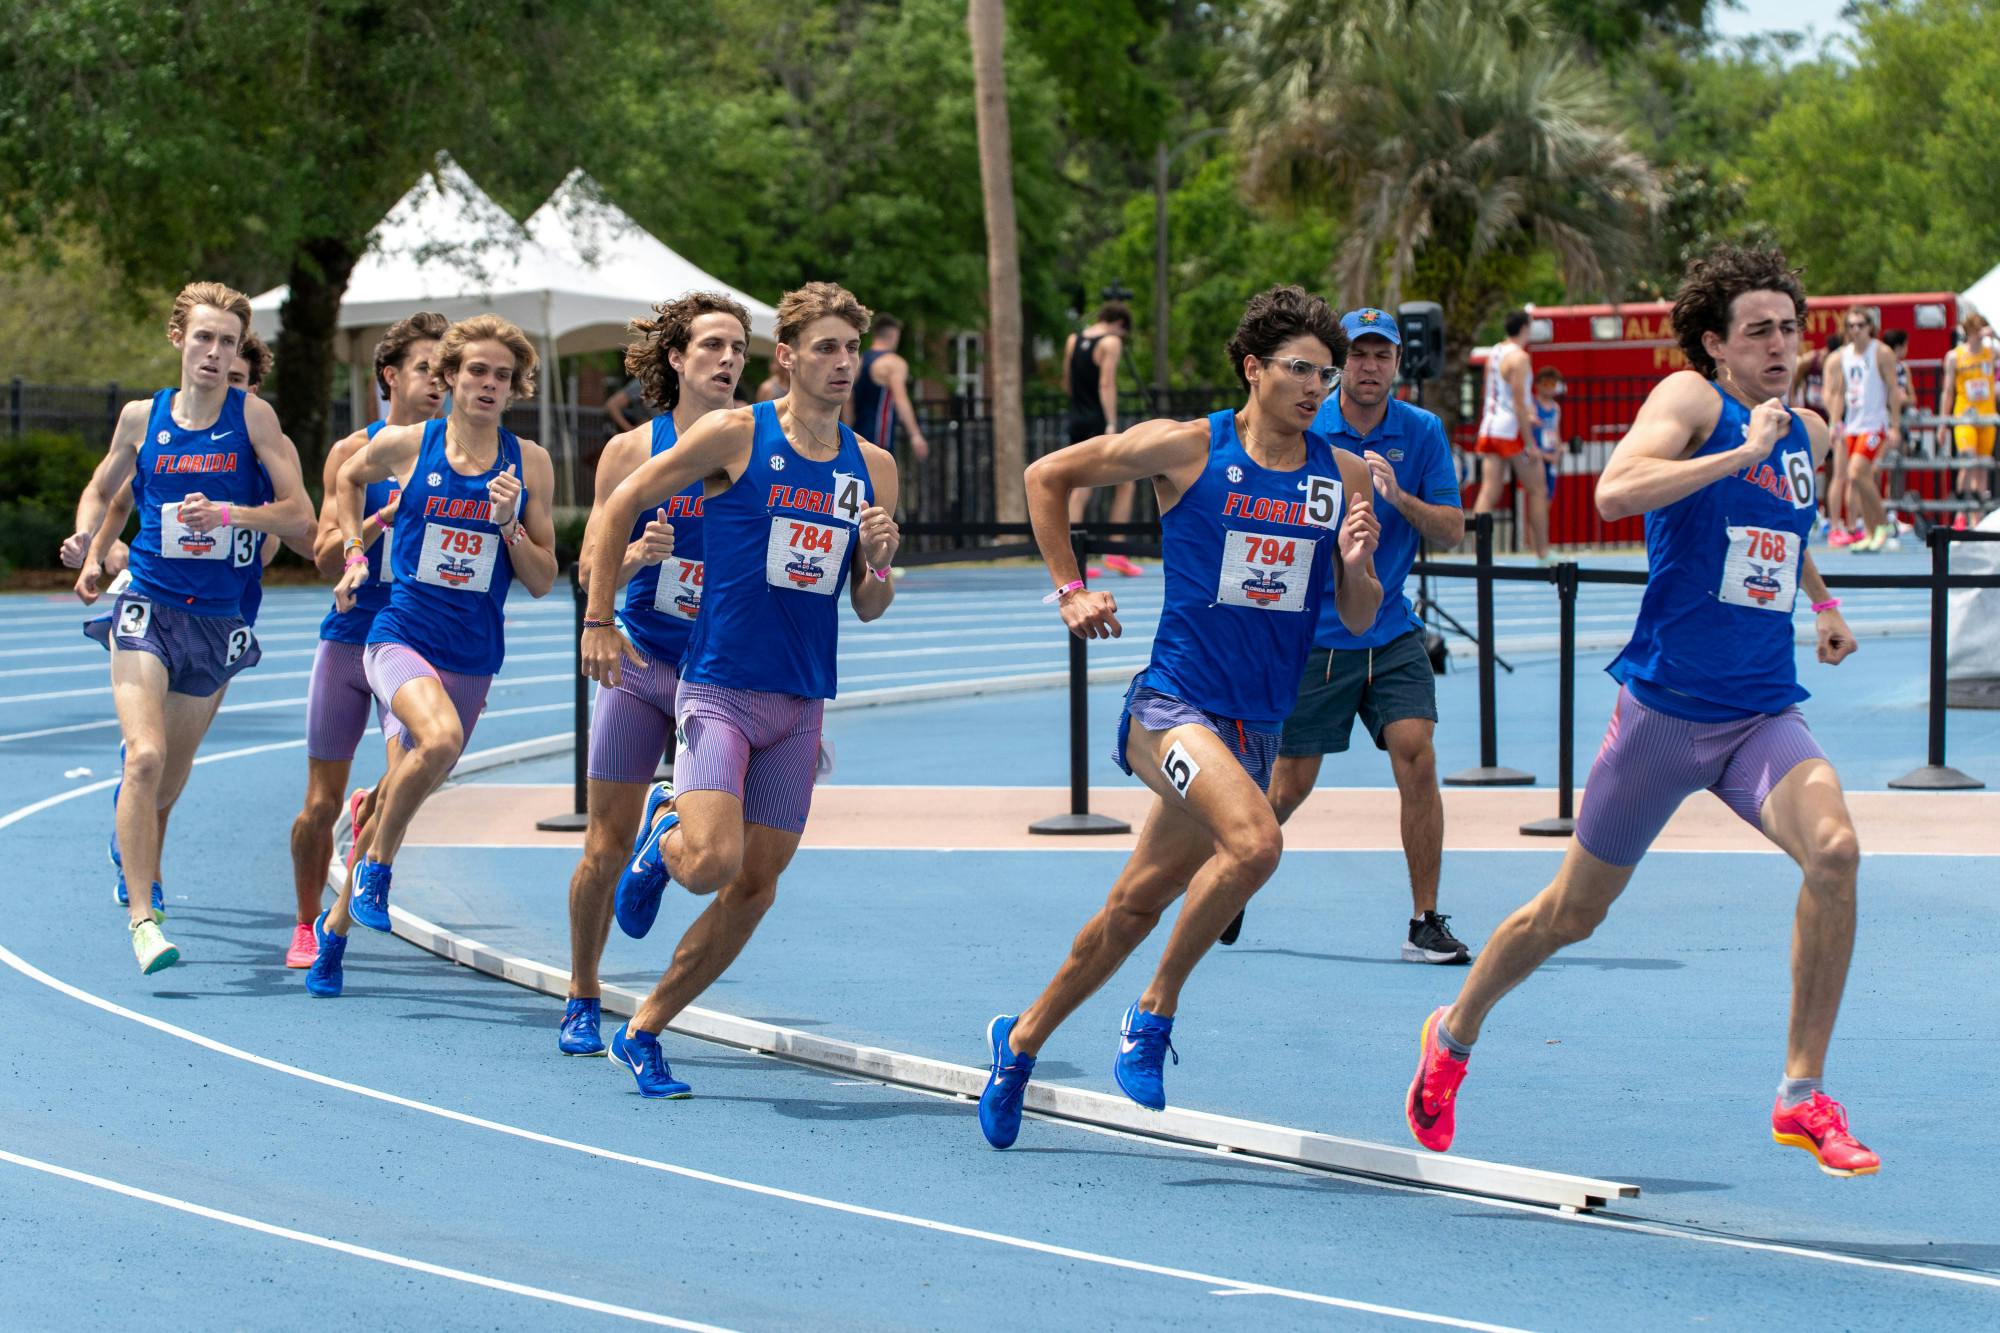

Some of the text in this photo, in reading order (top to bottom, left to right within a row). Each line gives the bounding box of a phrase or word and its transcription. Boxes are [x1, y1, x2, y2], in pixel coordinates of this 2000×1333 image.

[1625, 309, 1847, 339] ALA NTY
[154, 452, 238, 474] FLORIDA
[770, 456, 785, 471] SEC
[1227, 466, 1243, 482] SEC
[427, 472, 442, 487] SEC
[1789, 457, 1811, 504] 6
[424, 496, 492, 520] FLORI
[666, 495, 704, 517] FLO
[766, 484, 835, 515] FLORI
[838, 480, 860, 520] 4
[1222, 492, 1327, 531] FLORI
[1308, 479, 1334, 523] 5
[237, 529, 253, 563] 3
[440, 528, 483, 556] 793
[789, 522, 833, 554] 784
[1245, 535, 1296, 566] 794
[1745, 529, 1786, 563] 768
[679, 560, 704, 586] 78
[1244, 584, 1265, 593] FLORIDA
[121, 603, 145, 634] 3
[229, 630, 247, 662] 3
[1164, 749, 1190, 791] 5
